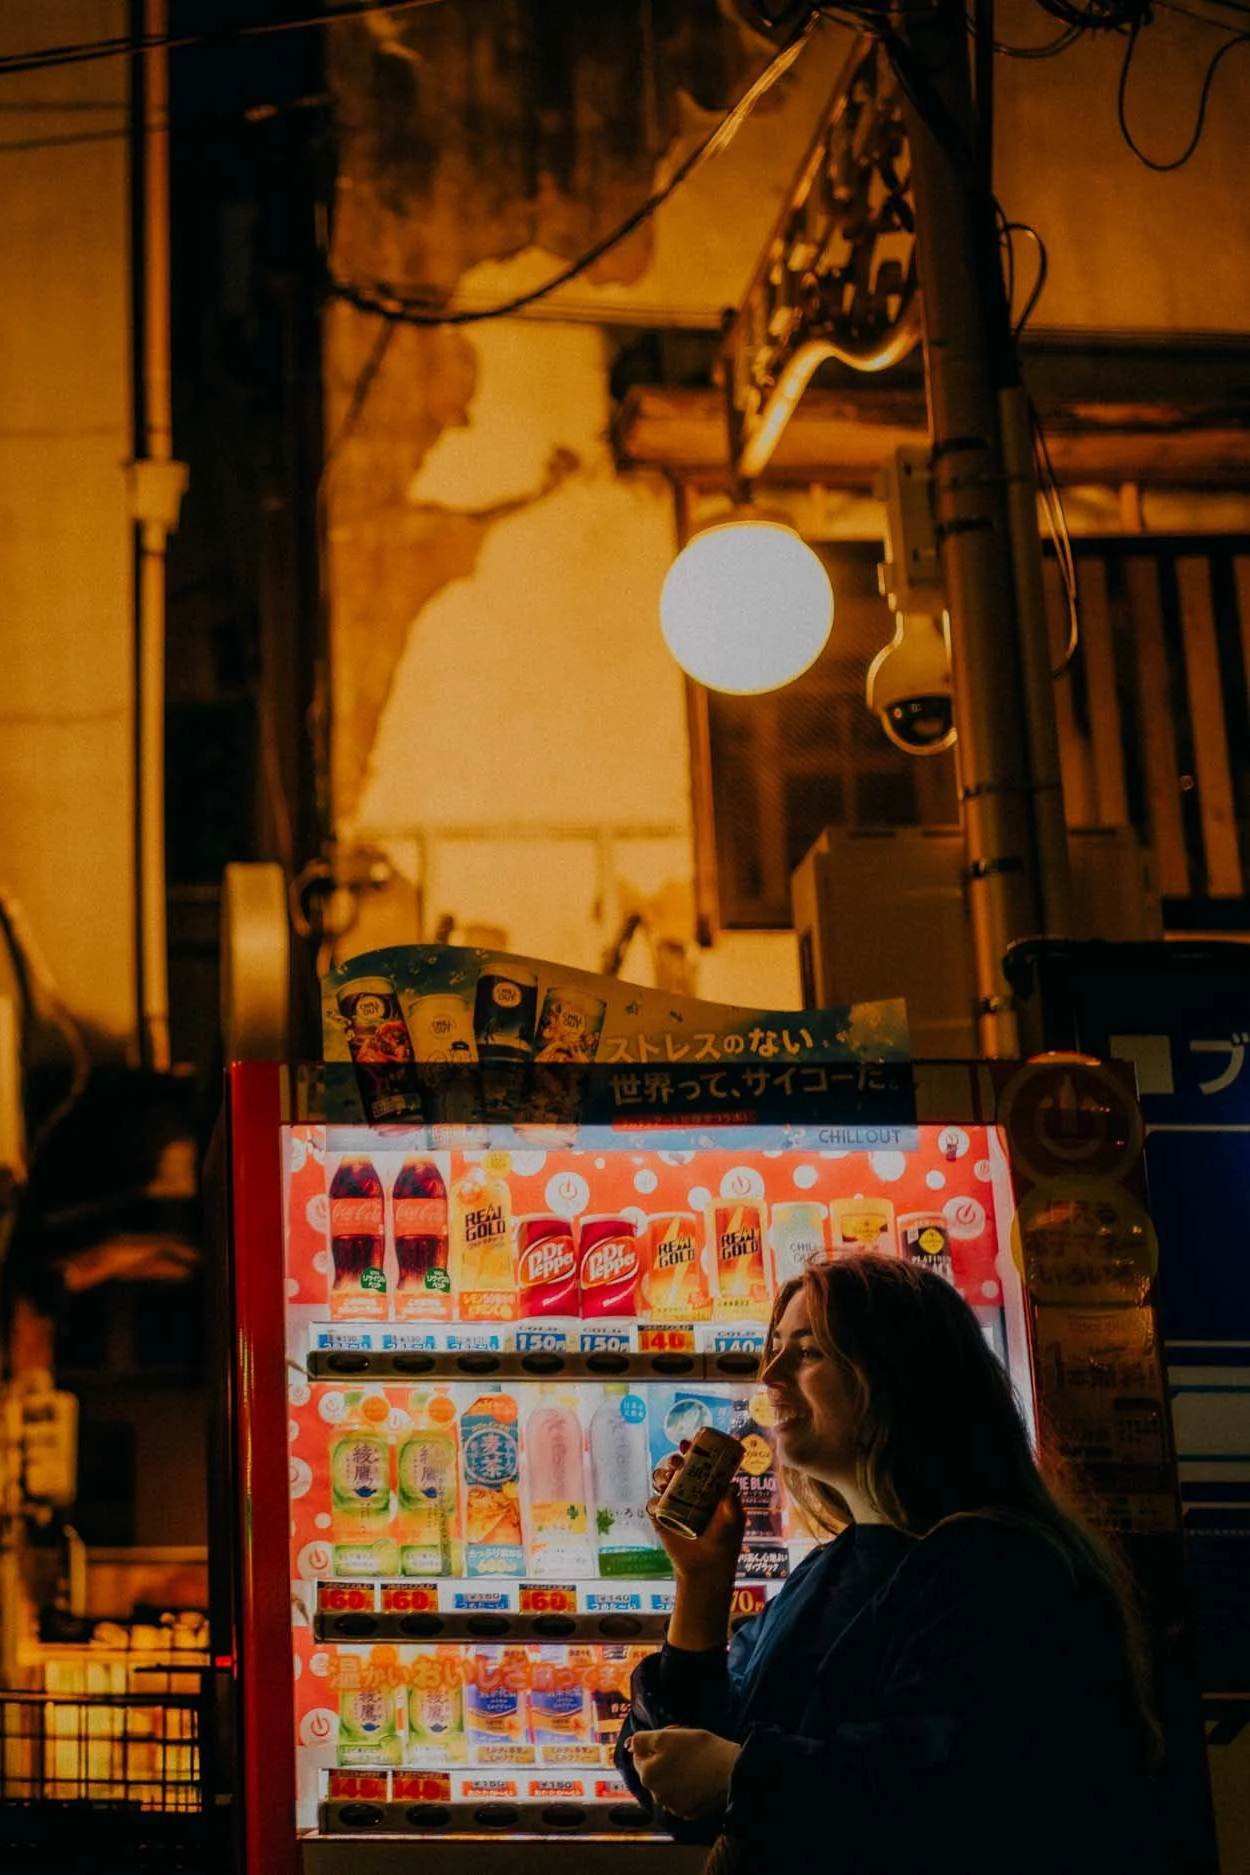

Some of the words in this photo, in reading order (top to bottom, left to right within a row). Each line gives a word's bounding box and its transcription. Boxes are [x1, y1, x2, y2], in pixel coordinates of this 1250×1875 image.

[604, 1026, 815, 1063] ストレスのない
[465, 1205, 502, 1228] REAL
[465, 1221, 506, 1242] GOLD
[721, 1229, 755, 1248] REAL
[542, 1242, 565, 1262] Dr
[604, 1243, 626, 1263] Dr
[658, 1236, 691, 1256] REAL
[722, 1240, 758, 1261] GOLD
[528, 1251, 574, 1281] Pepper
[589, 1251, 636, 1281] Pepper
[658, 1249, 695, 1268] GOLD
[353, 1442, 374, 1488] 綾鷹
[481, 1435, 501, 1478] 麦茶
